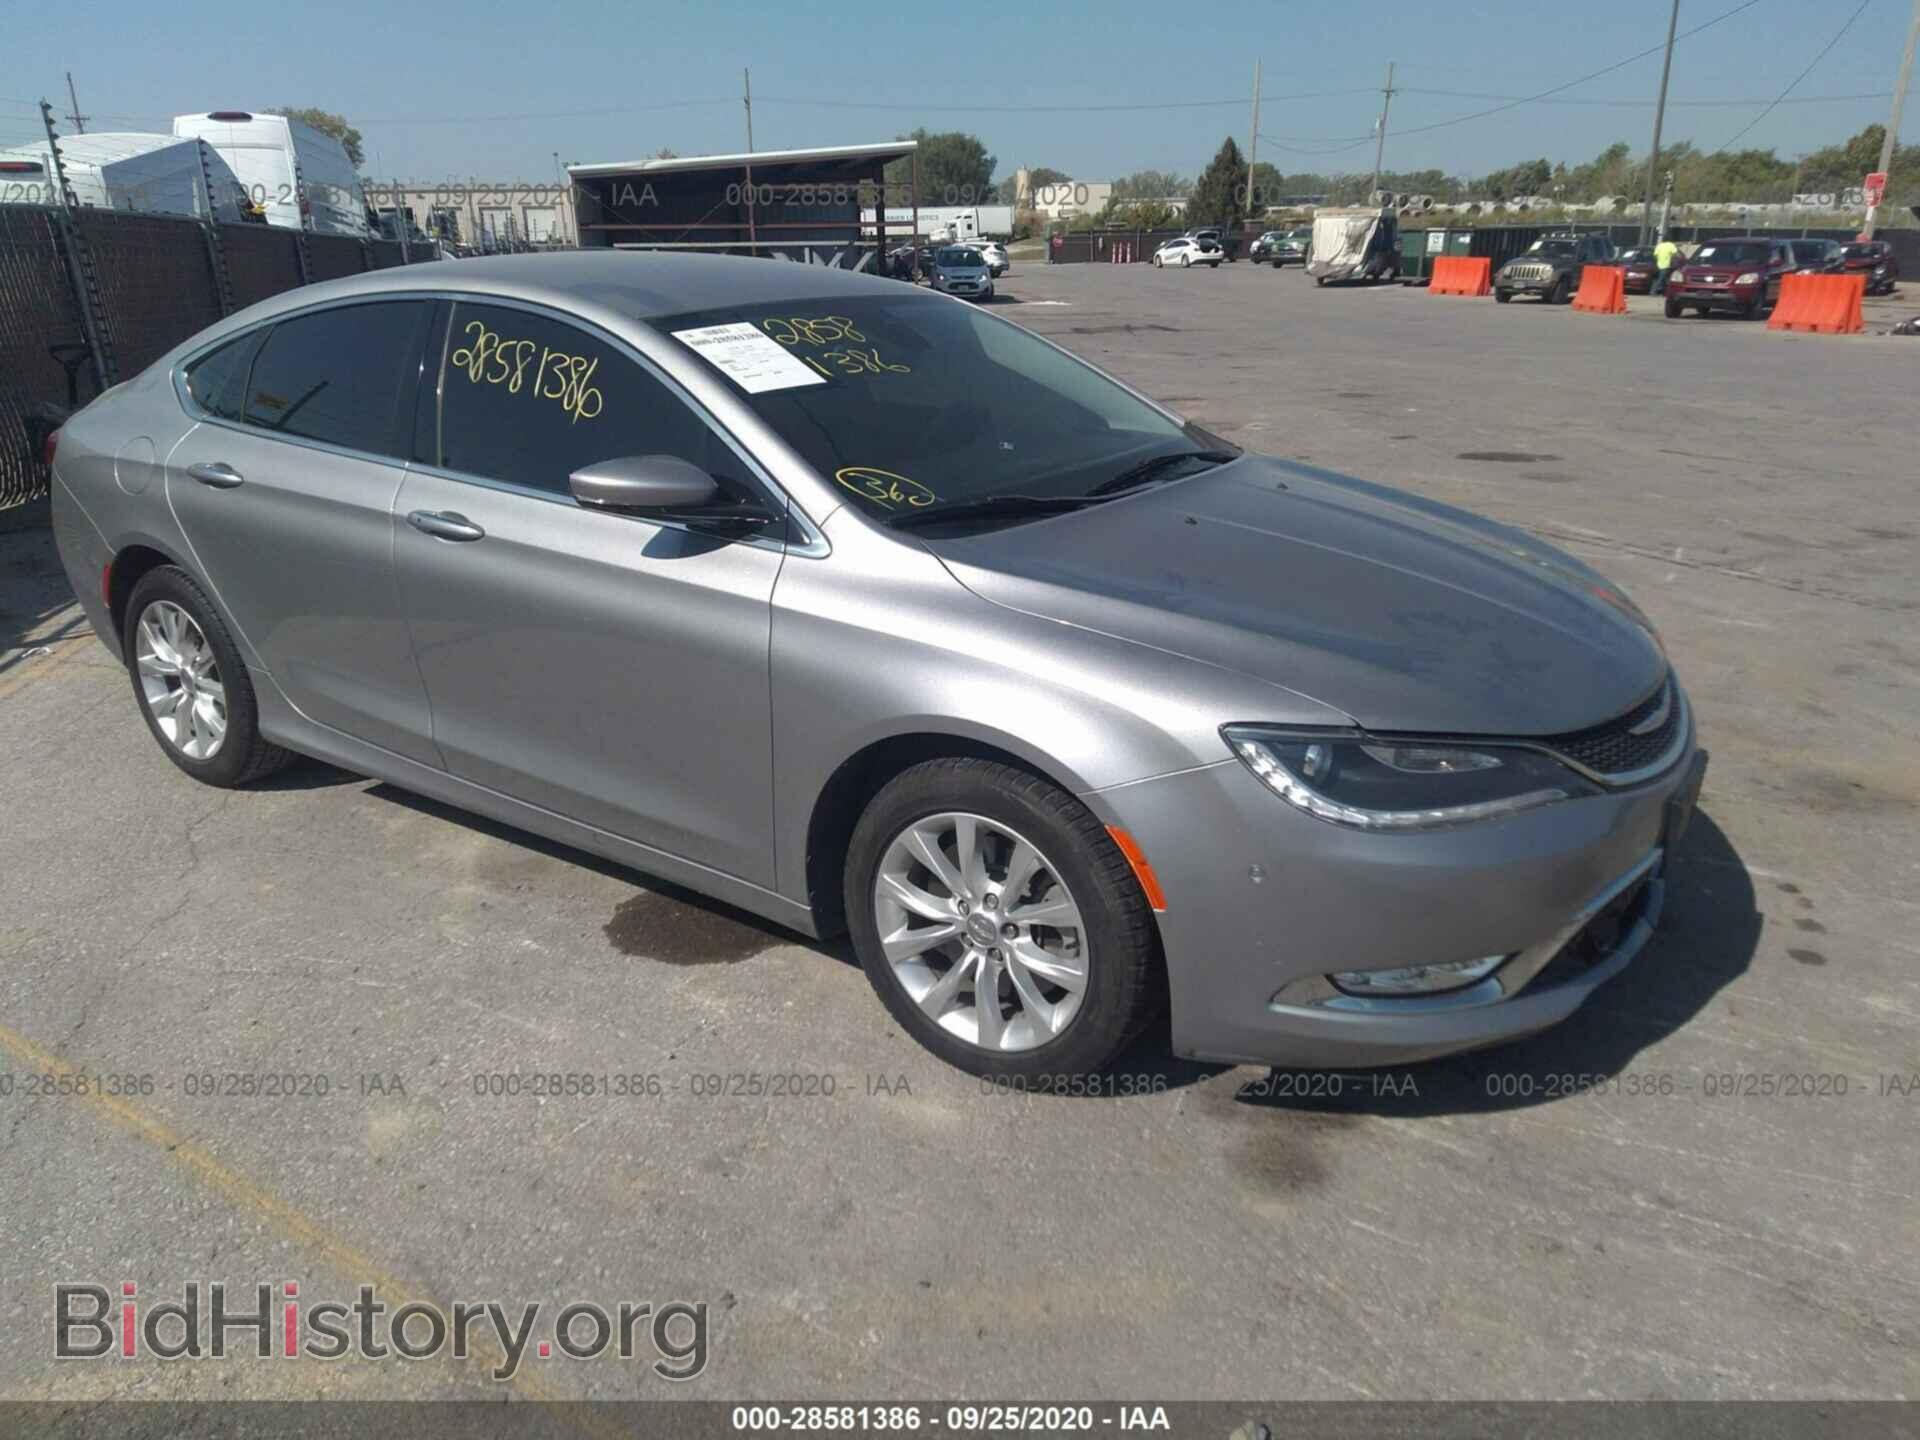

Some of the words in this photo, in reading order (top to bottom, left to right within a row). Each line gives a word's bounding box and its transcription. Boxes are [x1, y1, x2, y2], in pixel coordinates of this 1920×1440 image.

[763, 316, 866, 346] 2858
[452, 320, 602, 424] 28581386
[805, 348, 911, 377] 1386
